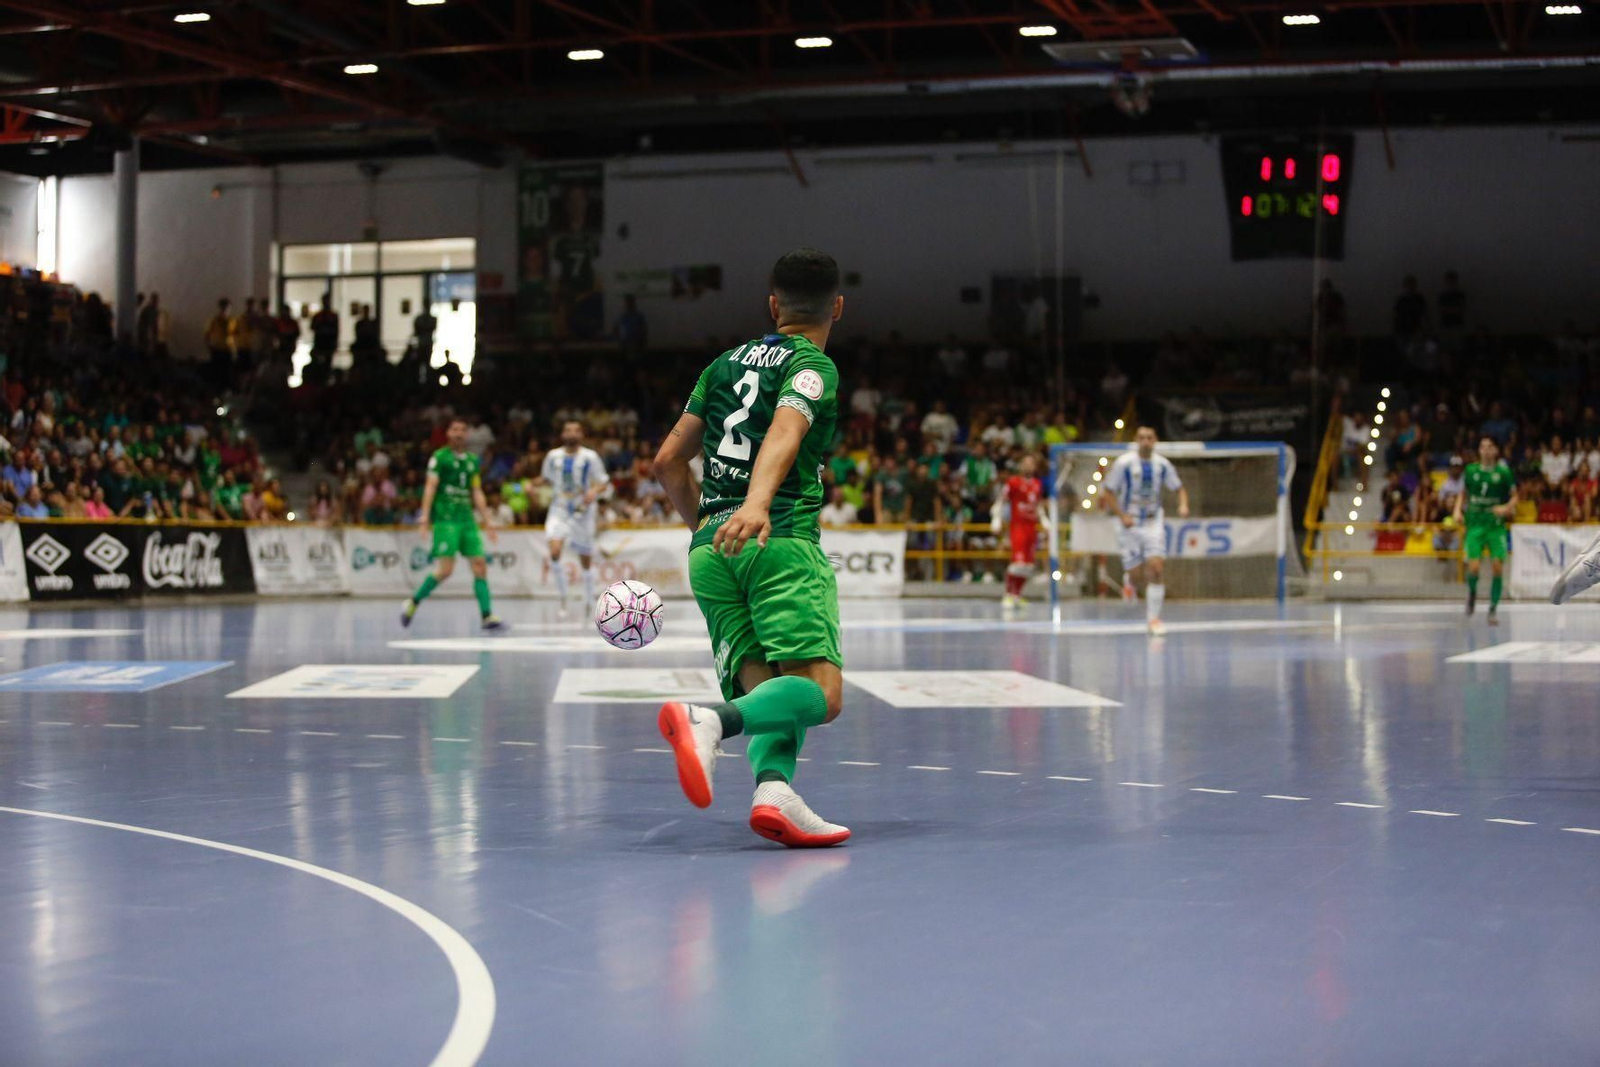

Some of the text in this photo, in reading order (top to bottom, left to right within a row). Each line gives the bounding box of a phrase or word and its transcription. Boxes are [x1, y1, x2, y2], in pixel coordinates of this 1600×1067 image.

[1321, 154, 1340, 182] 0
[522, 191, 549, 228] 10
[1322, 194, 1340, 216] 4
[569, 252, 586, 277] 7
[728, 344, 747, 362] D.
[716, 369, 760, 461] 2
